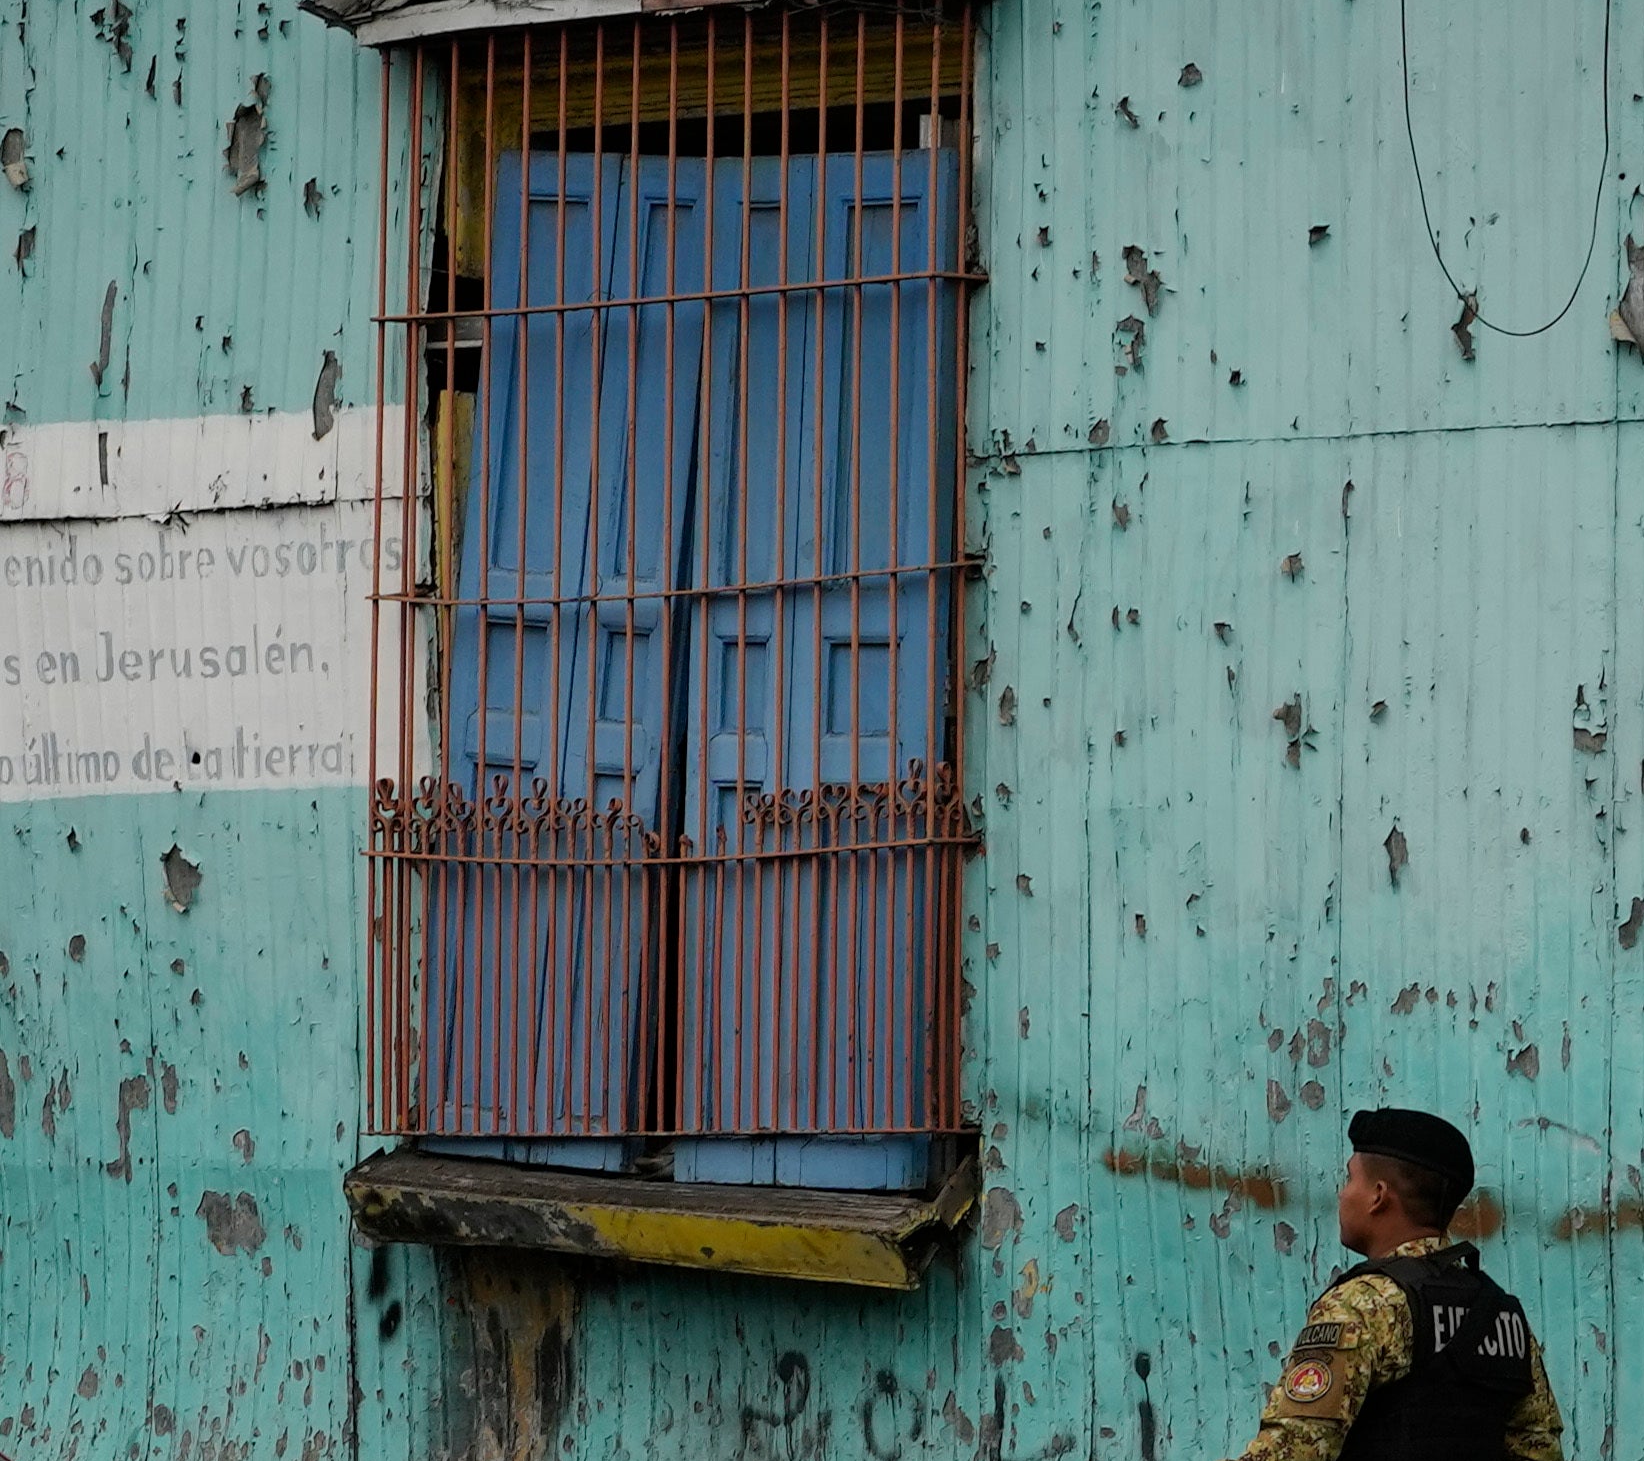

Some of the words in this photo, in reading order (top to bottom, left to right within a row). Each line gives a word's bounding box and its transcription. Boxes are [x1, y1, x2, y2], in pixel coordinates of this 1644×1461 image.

[5, 535, 104, 587] enido
[114, 527, 217, 585] sobre
[36, 650, 80, 686] en
[97, 623, 331, 682] Jerusalén.
[22, 730, 122, 786] último
[131, 731, 175, 782] de
